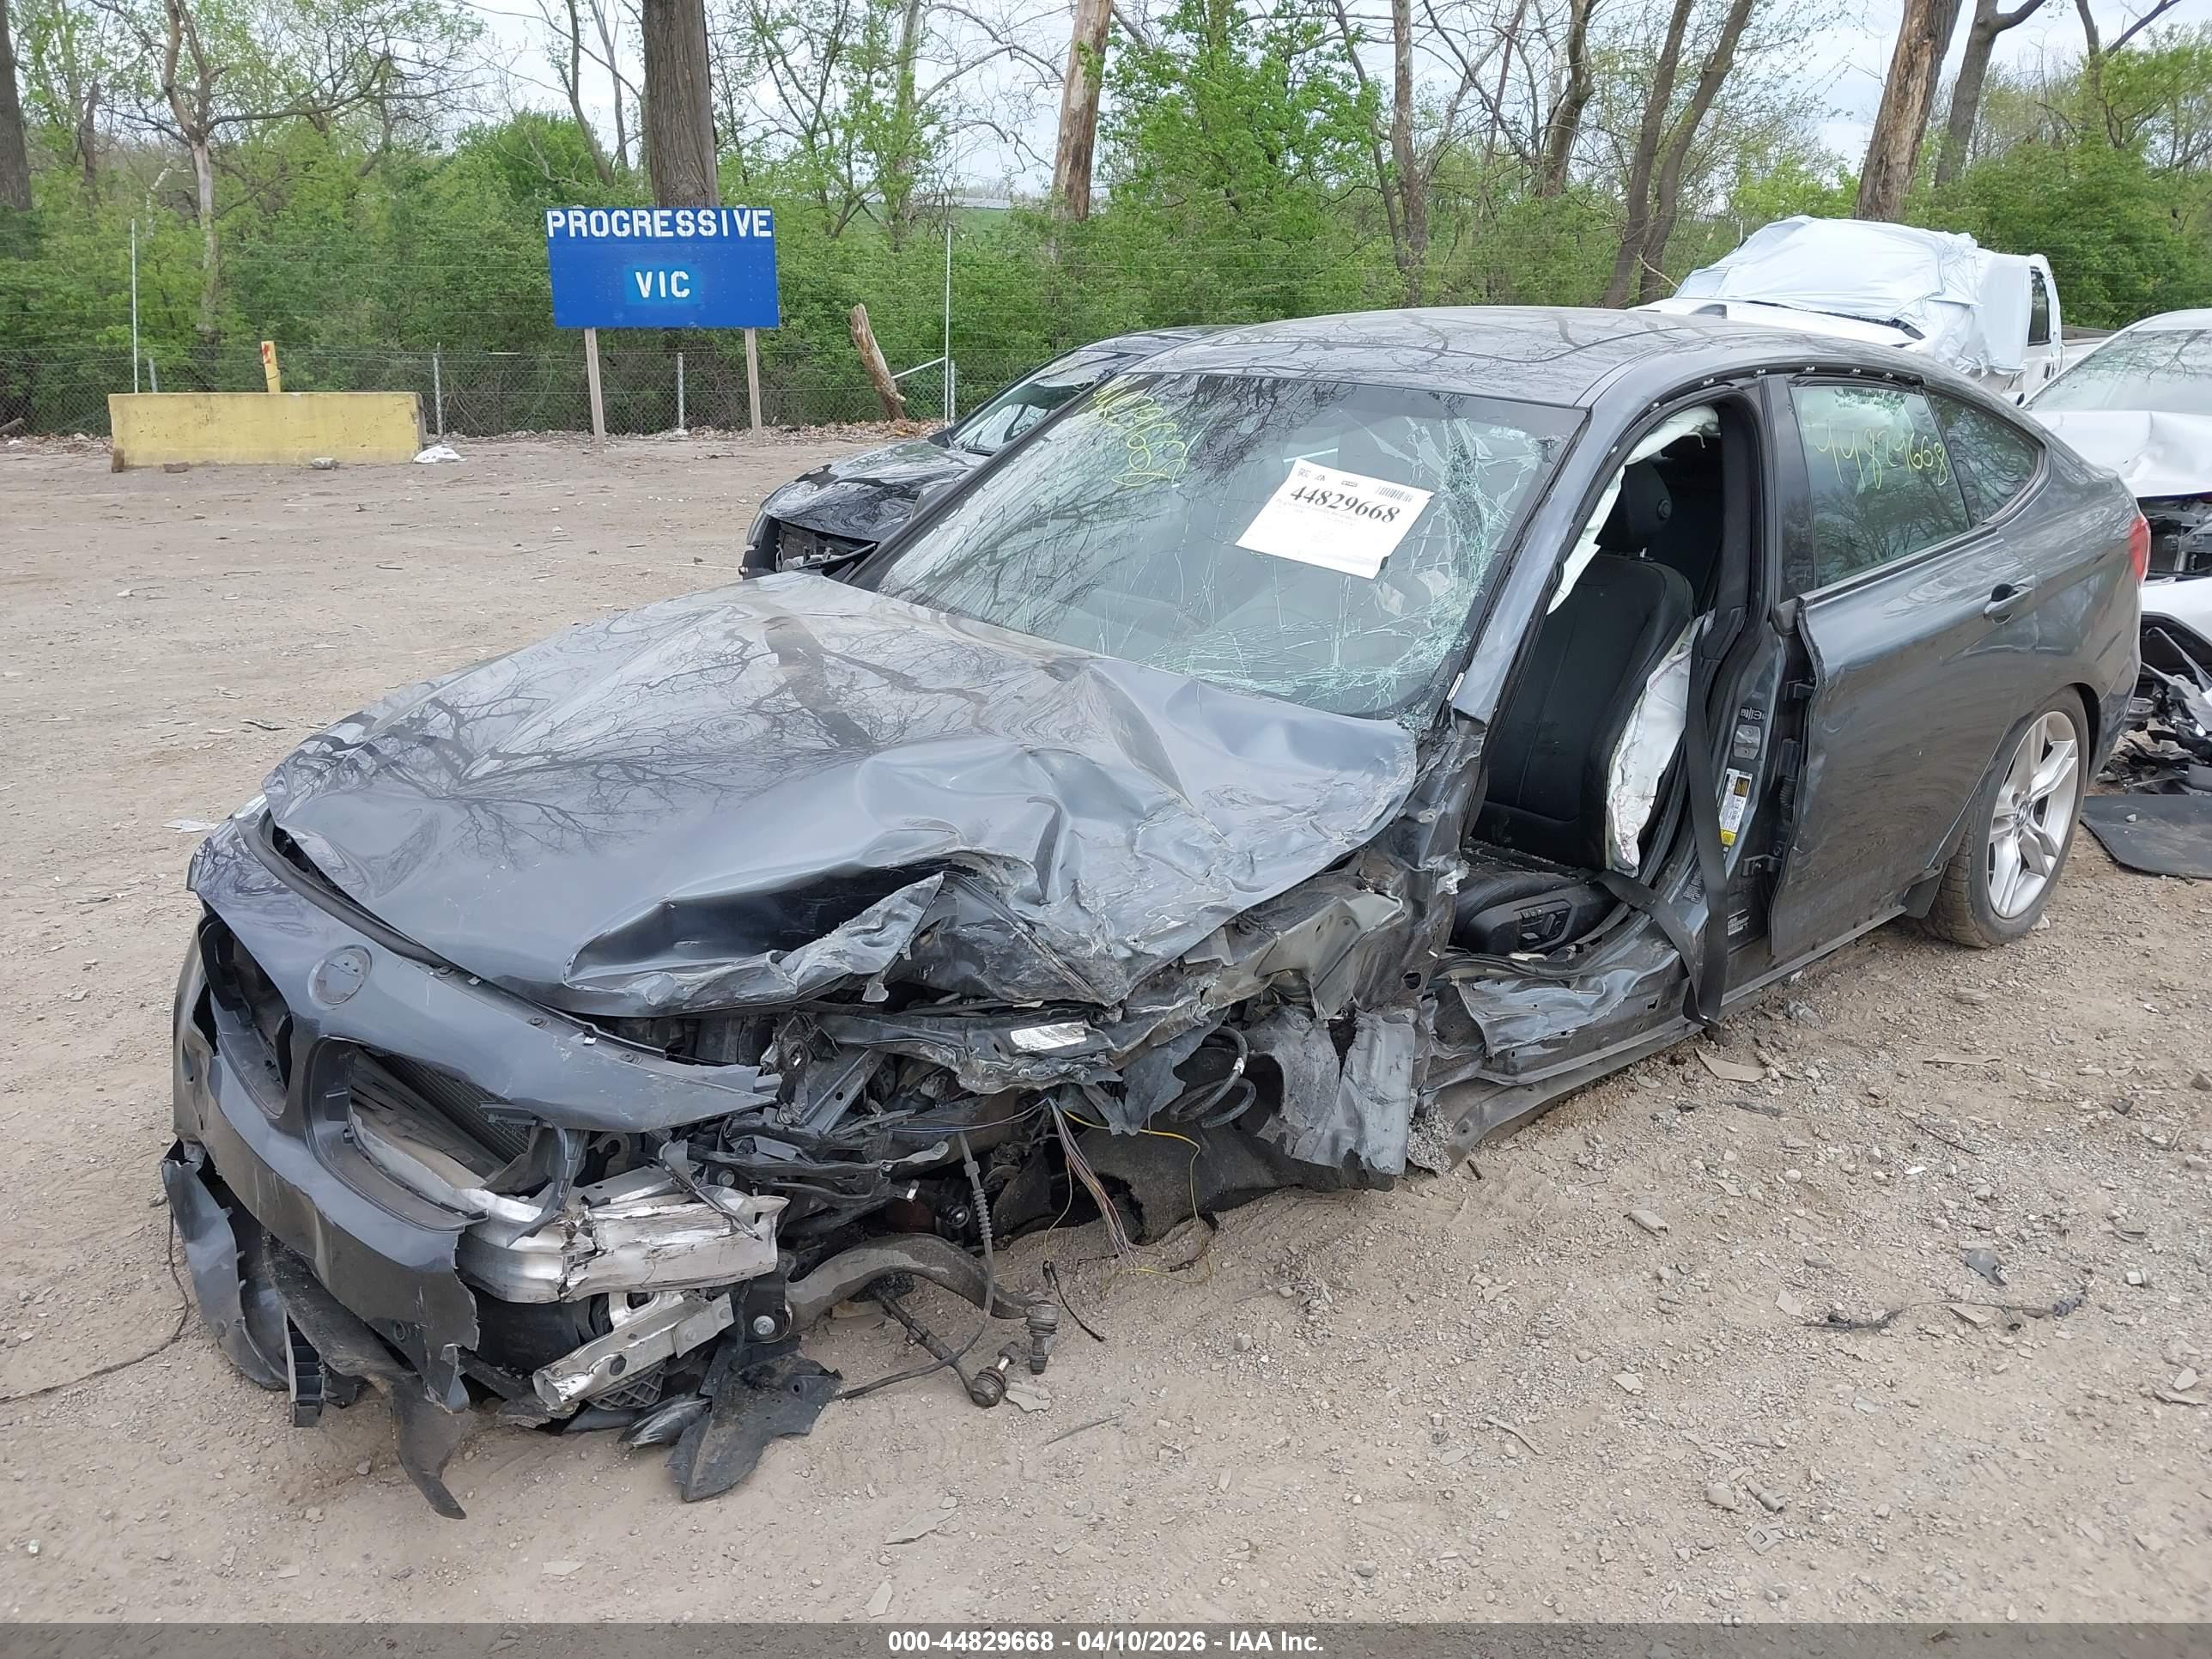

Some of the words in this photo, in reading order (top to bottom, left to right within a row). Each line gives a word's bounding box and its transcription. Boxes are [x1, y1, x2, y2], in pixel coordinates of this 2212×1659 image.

[546, 209, 773, 238] PROGRESSIVE
[635, 270, 690, 298] VIC
[1289, 485, 1401, 524] 44829668
